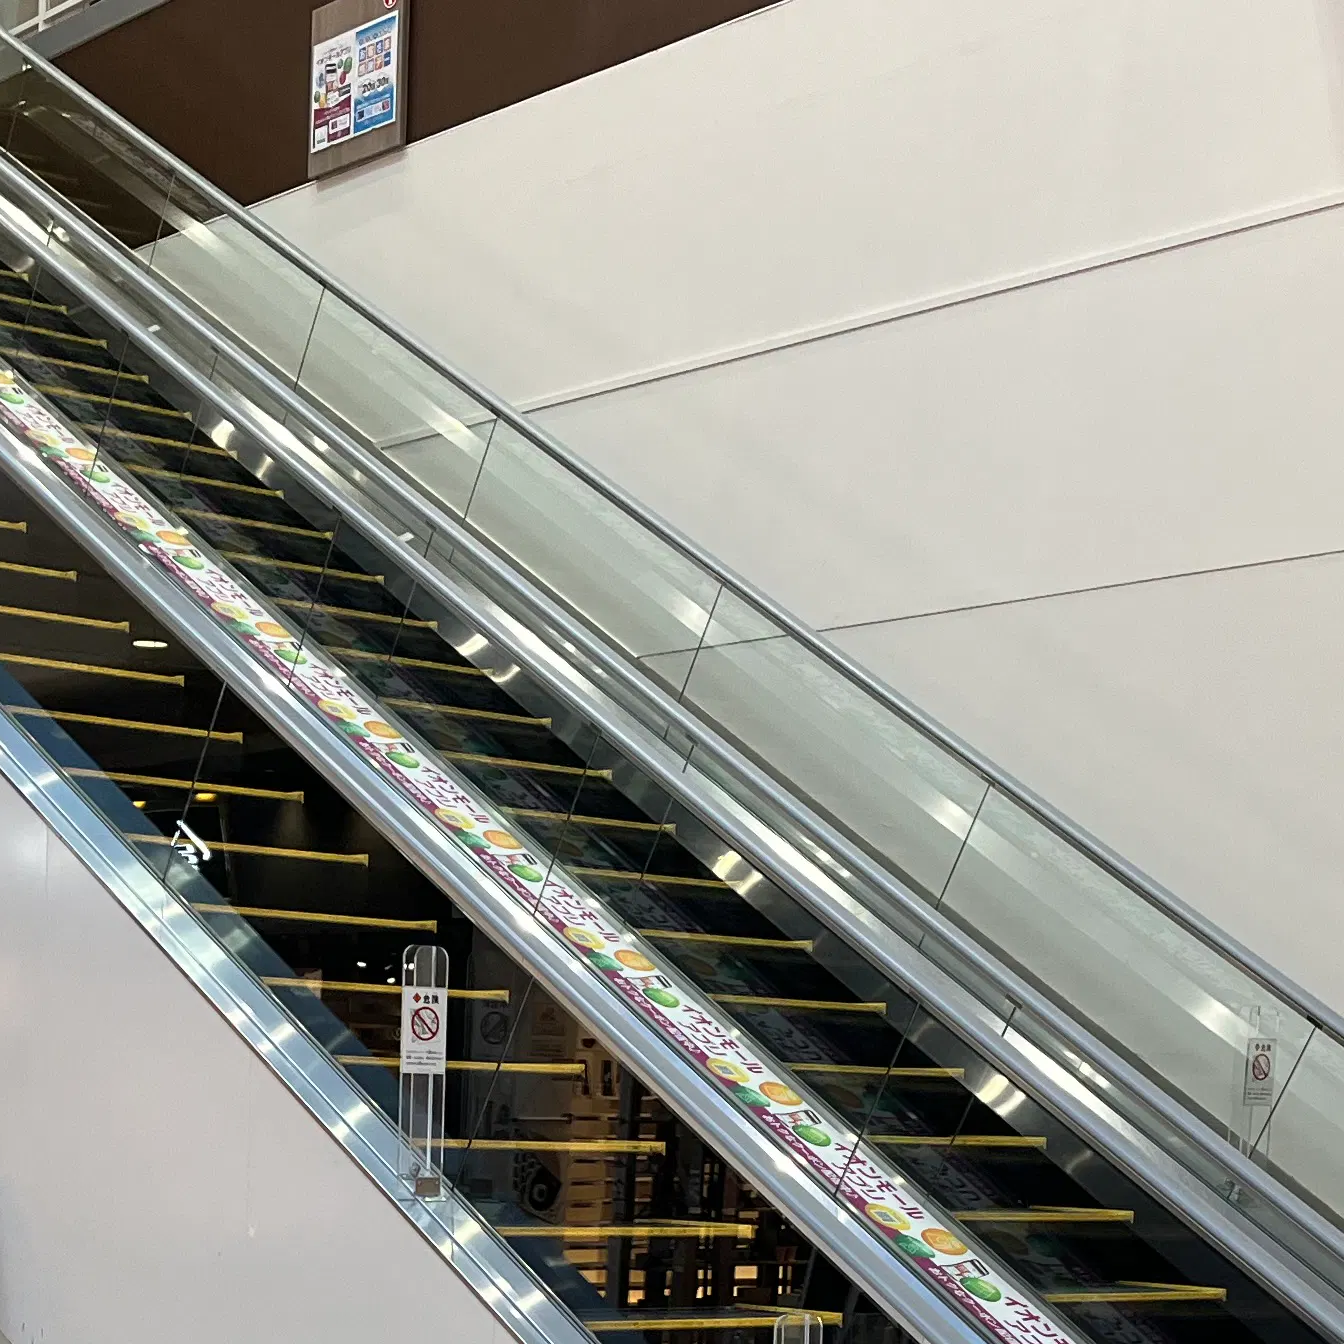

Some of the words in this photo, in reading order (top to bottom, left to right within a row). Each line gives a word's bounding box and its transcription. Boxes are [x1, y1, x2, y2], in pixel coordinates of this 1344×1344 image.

[544, 879, 620, 943] イオンモール
[677, 1020, 727, 1057] アプリ
[682, 1004, 764, 1074] イオンモール
[831, 1162, 886, 1201] アプリ
[834, 1142, 925, 1220] イオンモール
